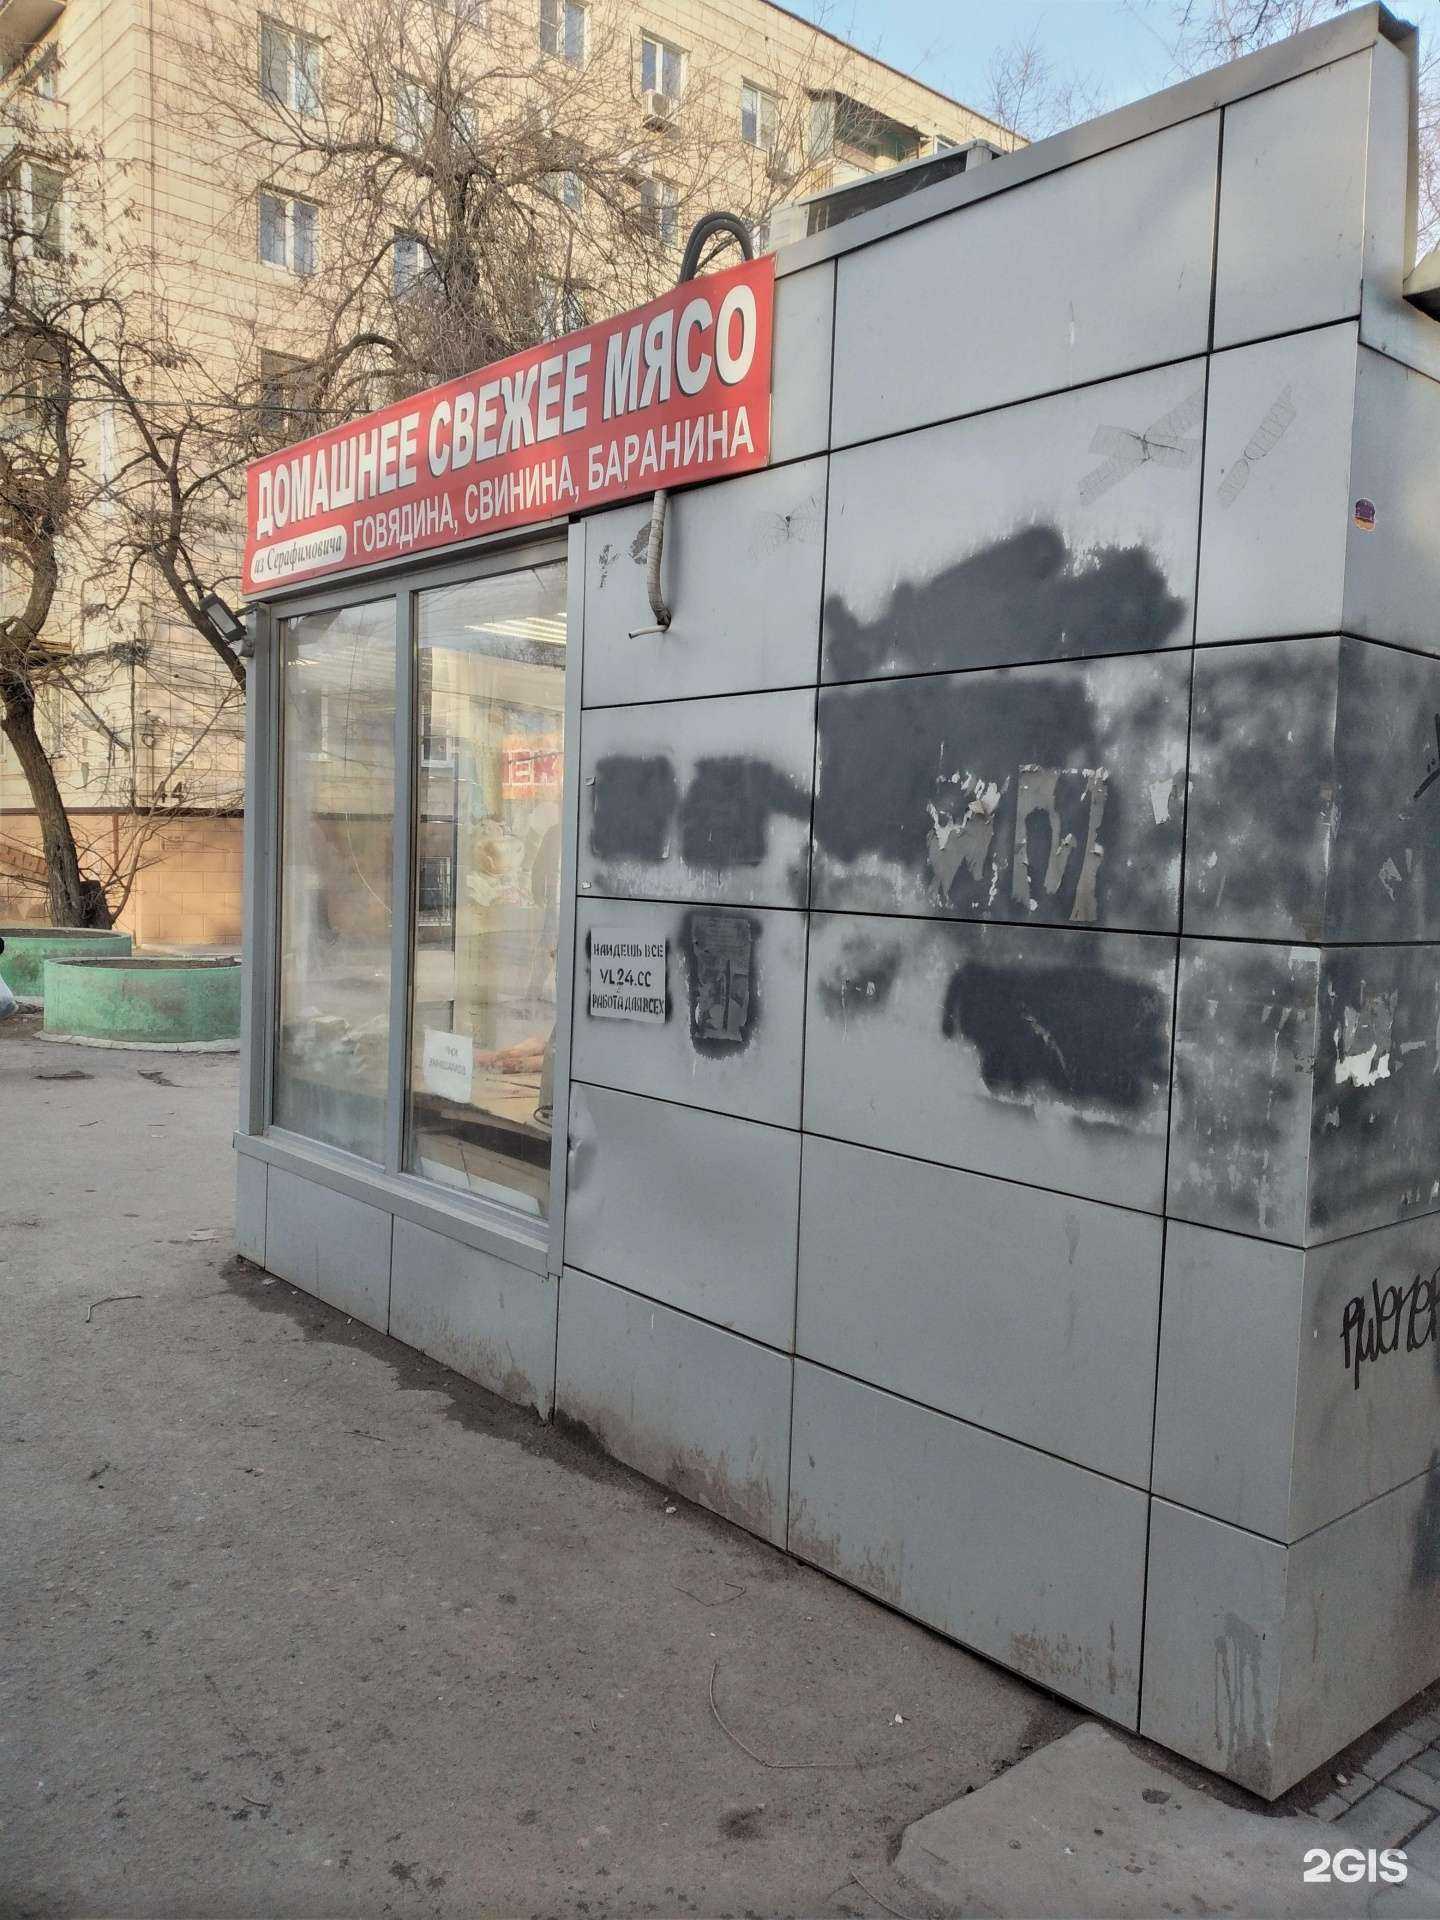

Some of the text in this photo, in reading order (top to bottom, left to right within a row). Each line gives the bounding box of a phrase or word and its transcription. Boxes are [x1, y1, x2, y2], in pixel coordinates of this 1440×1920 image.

[256, 284, 757, 541] ДОМАШНЕЕ СВЕЖЕЕ МЯСО
[352, 405, 755, 555] ГОВЯДИНА, СВИНИНА, БАРАНИНА
[254, 534, 343, 574] из Серафимовича
[645, 944, 664, 958] ВСЕ
[592, 994, 624, 1010] РАБОТА
